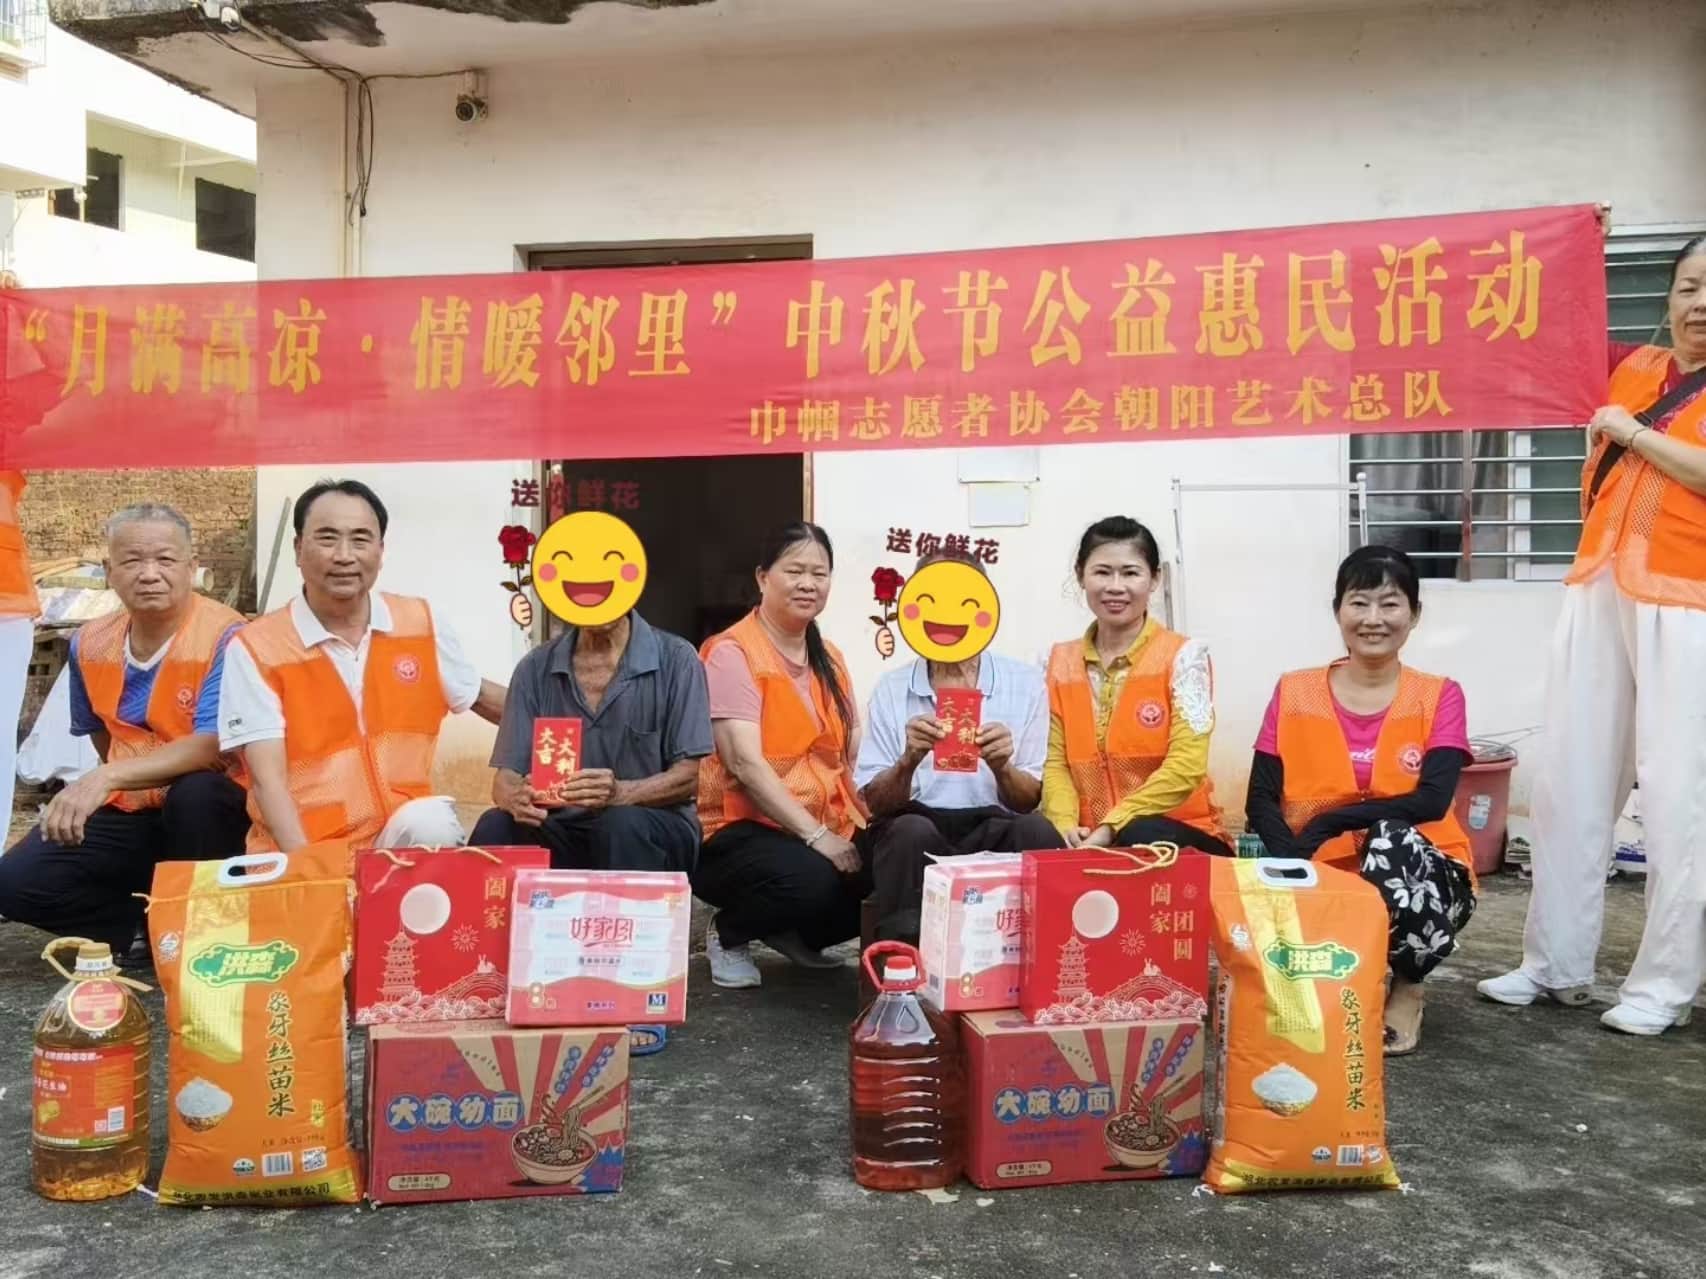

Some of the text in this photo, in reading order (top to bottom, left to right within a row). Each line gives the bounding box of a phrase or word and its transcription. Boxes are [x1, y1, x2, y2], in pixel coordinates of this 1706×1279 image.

[748, 370, 1455, 446] 巾帼志愿者协会朝阳艺术总队
